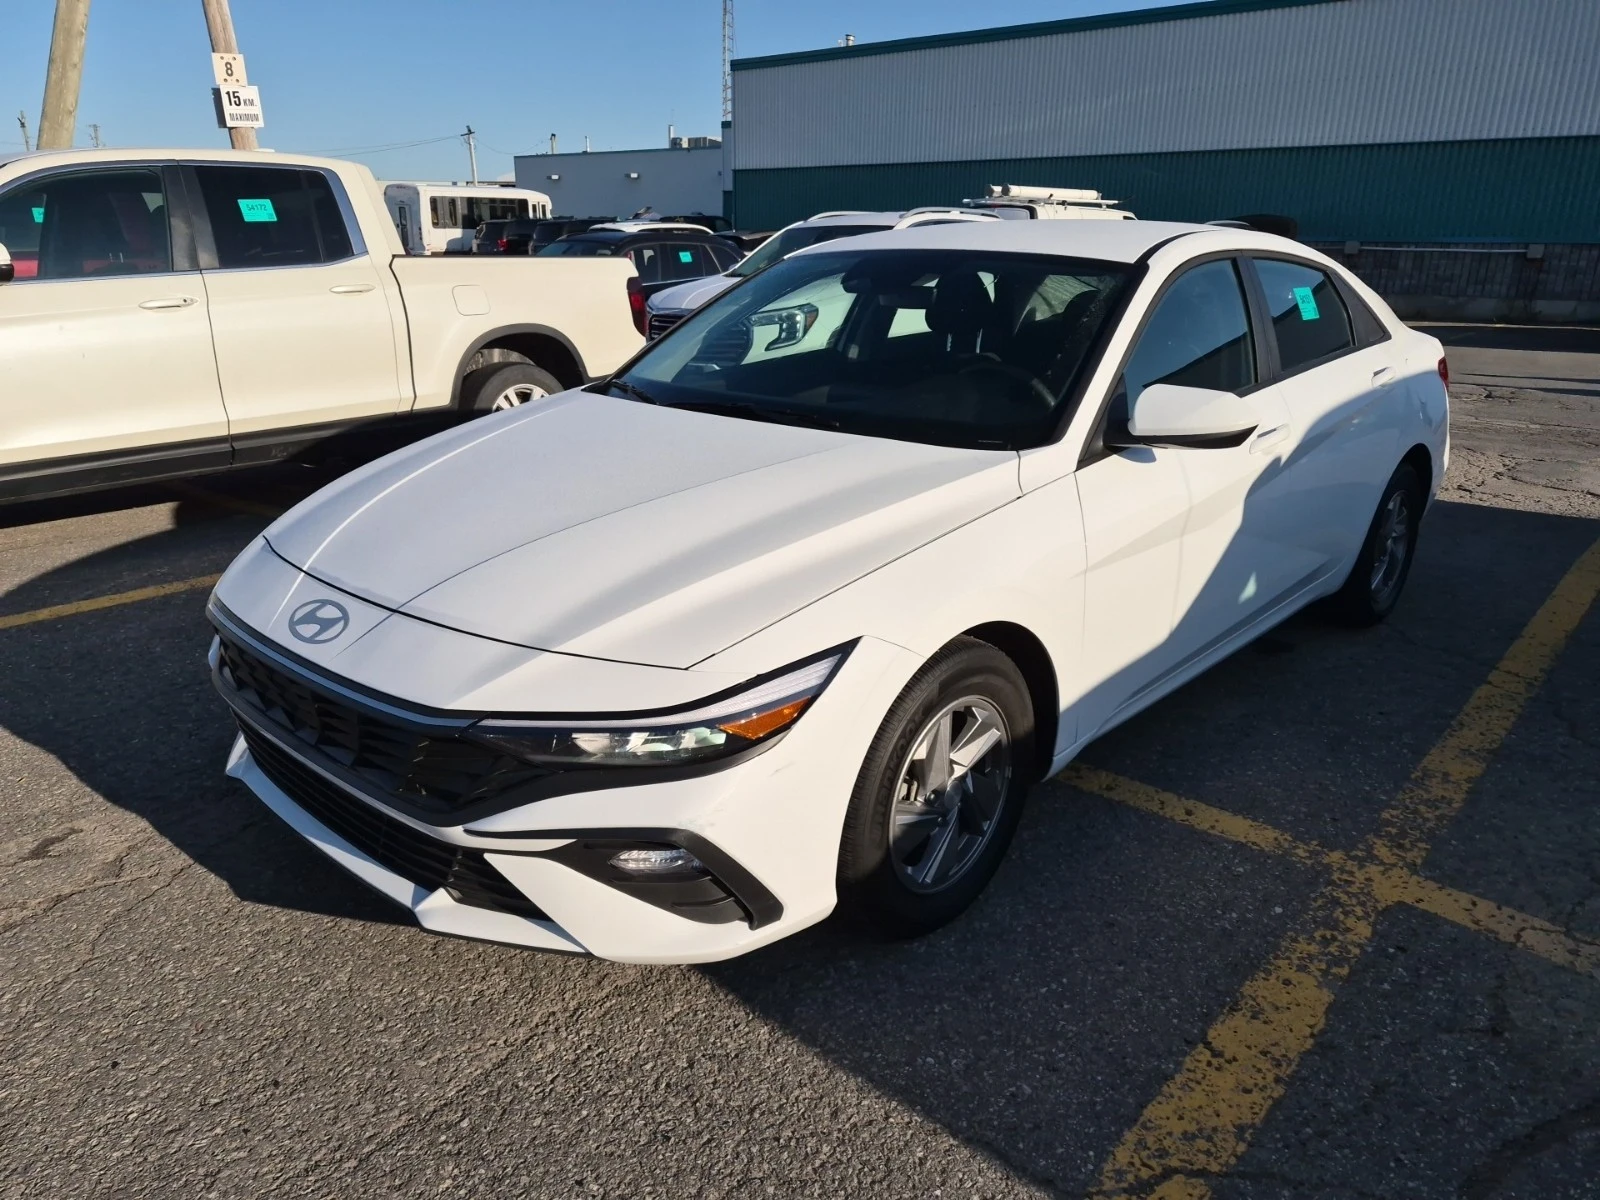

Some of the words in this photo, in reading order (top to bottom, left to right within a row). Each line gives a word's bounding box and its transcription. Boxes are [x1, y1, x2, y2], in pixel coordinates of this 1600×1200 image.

[225, 61, 234, 77] 8
[225, 91, 242, 107] 15
[229, 112, 260, 122] MAXIMUM
